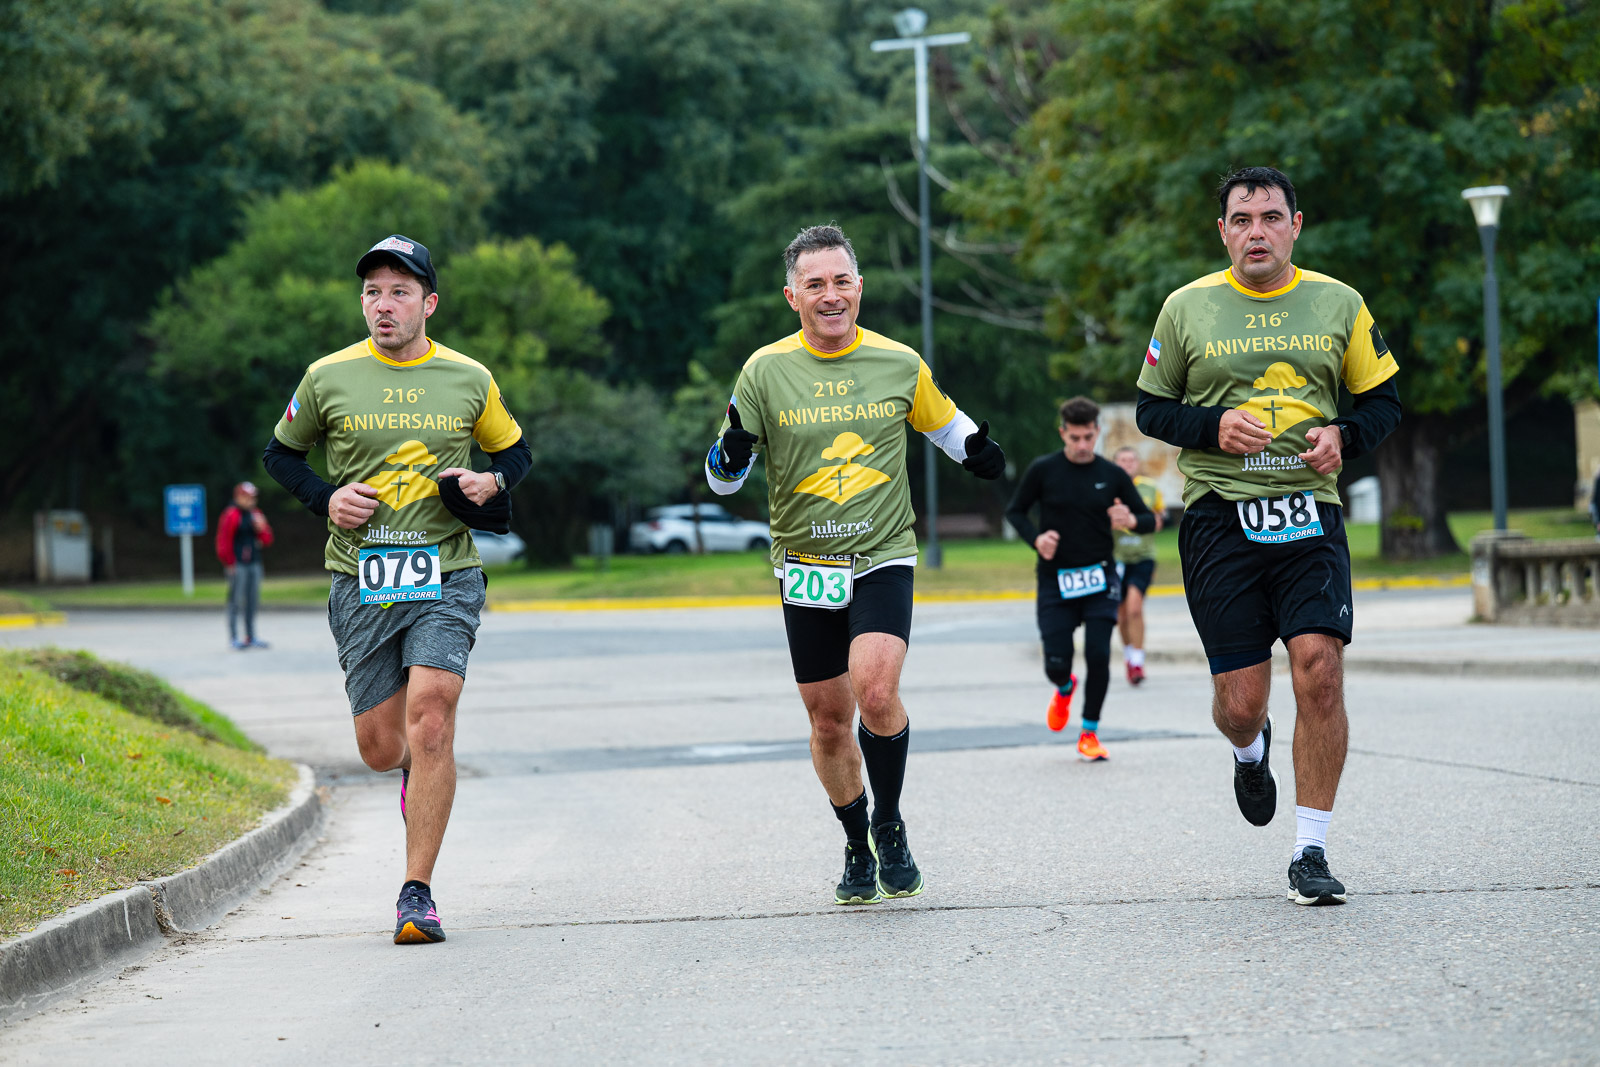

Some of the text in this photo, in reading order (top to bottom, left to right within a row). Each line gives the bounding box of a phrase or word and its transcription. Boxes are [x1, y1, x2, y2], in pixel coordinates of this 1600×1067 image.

[1245, 311, 1289, 329] 216°
[1204, 334, 1333, 359] ANIVERSARIO
[383, 387, 426, 404] 216°
[813, 379, 855, 398] 216°
[343, 413, 464, 433] ANIVERSARIO
[778, 401, 896, 427] ANIVERSARIO
[1242, 491, 1312, 533] 058
[362, 523, 427, 541] julicroc
[1250, 527, 1318, 542] DIAMANTE CORRE
[363, 549, 433, 592] 079
[1063, 567, 1100, 591] 036
[788, 567, 846, 603] 203
[364, 591, 437, 603] DIAMANTE CORRE
